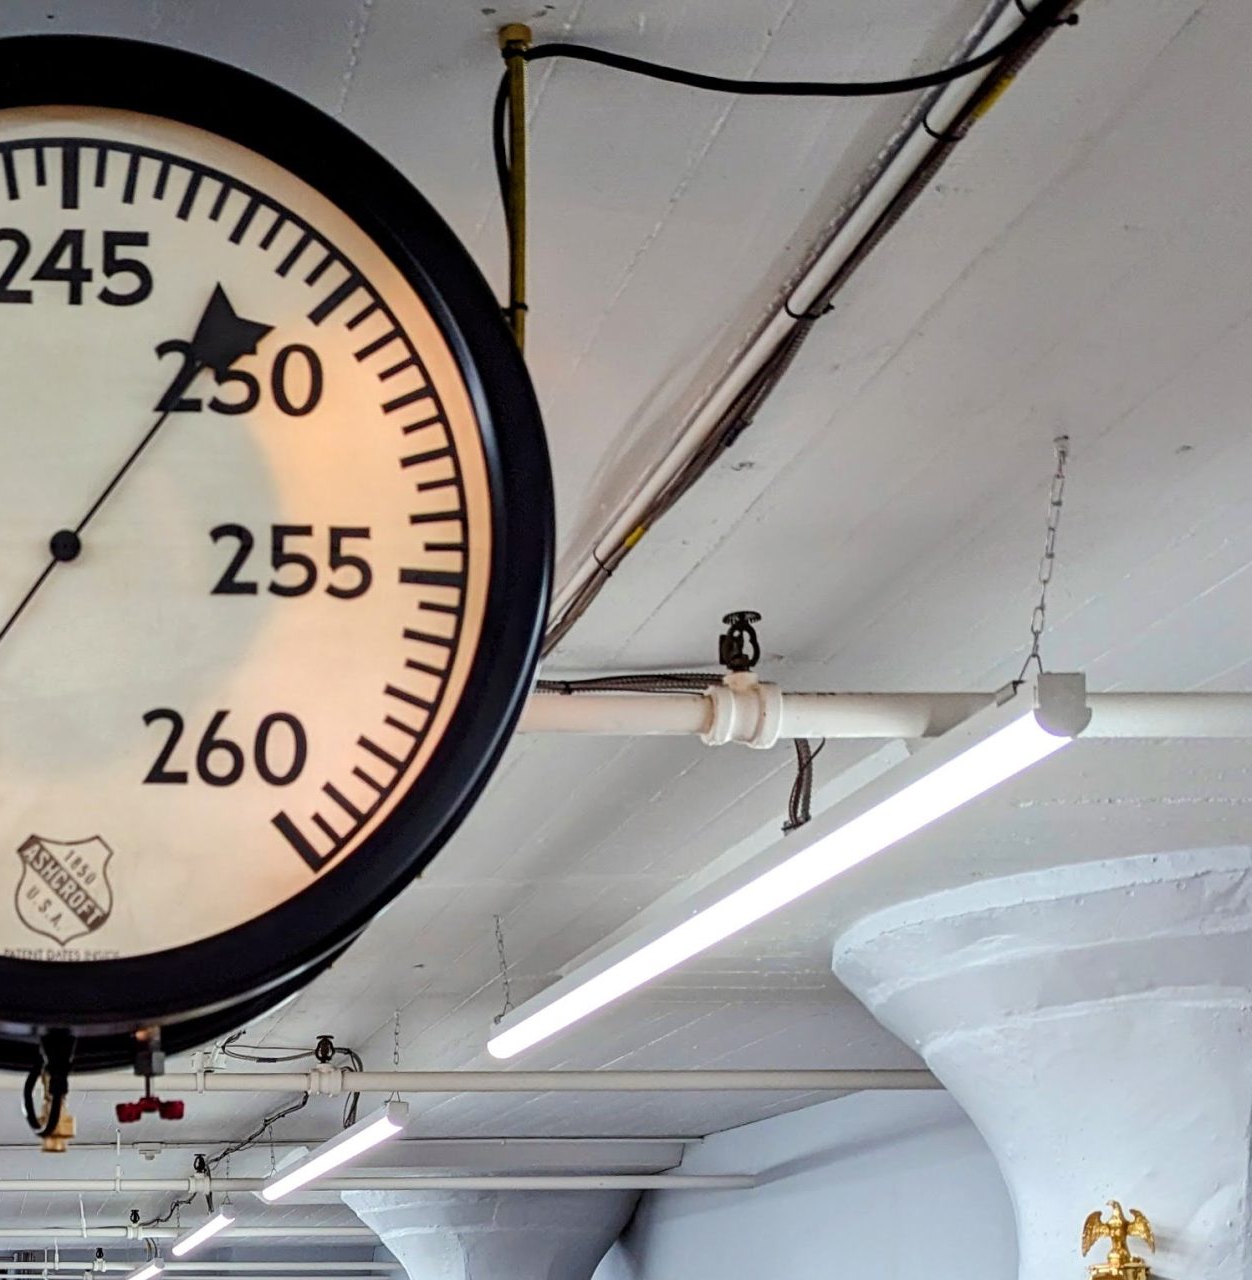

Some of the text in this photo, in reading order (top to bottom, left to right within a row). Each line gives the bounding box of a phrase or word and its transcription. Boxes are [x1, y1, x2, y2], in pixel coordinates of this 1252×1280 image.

[210, 524, 373, 599] 255
[142, 709, 308, 786] 260
[23, 844, 104, 924] ASHCROFT
[64, 850, 96, 885] 1850
